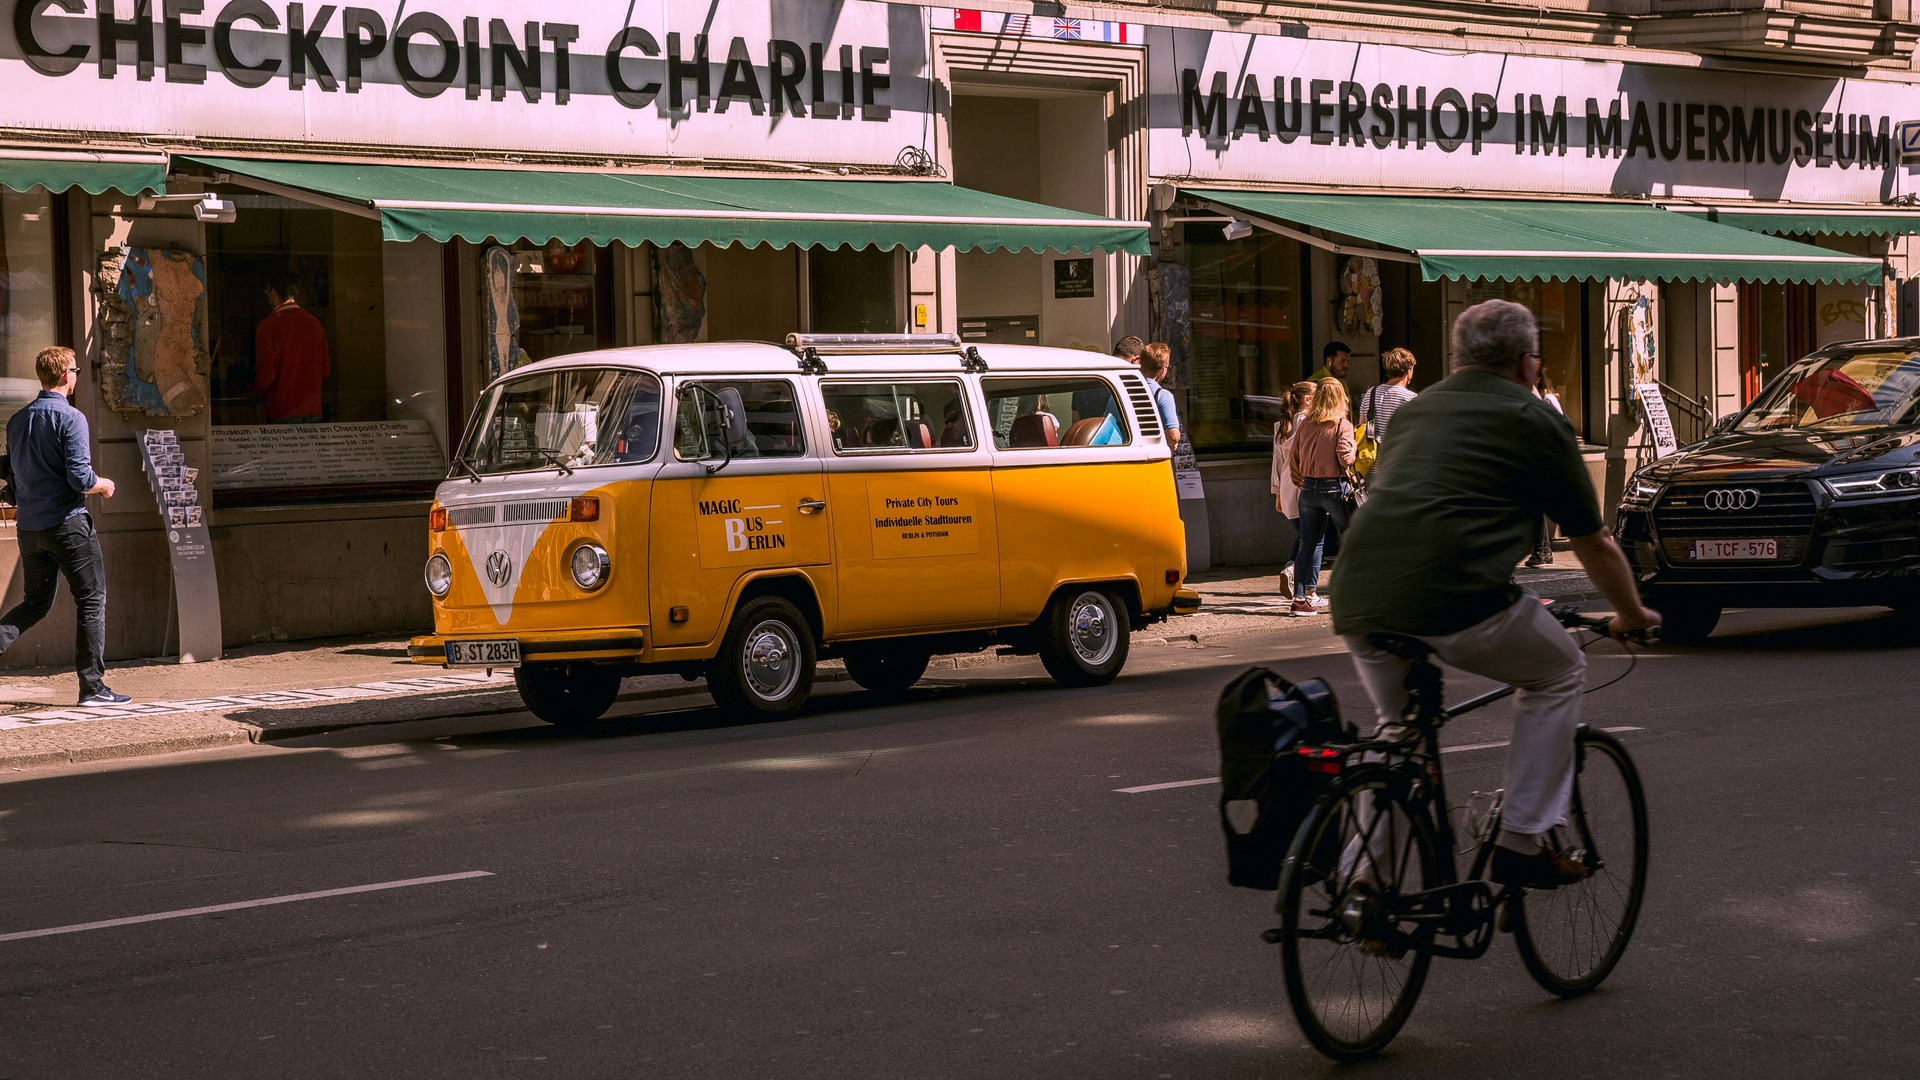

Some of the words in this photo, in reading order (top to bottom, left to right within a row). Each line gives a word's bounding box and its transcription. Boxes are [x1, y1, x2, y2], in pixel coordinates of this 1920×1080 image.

[14, 0, 579, 105] CHECKPOINT
[606, 27, 891, 122] CHARLIE
[1182, 68, 1498, 156] MAUERSHOP
[1515, 93, 1567, 157] IM
[1585, 97, 1890, 170] MAUERMUSEUM
[259, 427, 295, 435] Museum
[295, 426, 318, 434] Haus
[333, 424, 379, 433] Checkpoint
[380, 423, 409, 431] Charlie
[699, 499, 741, 515] MAGIC
[885, 497, 915, 508] Private
[917, 496, 932, 508] City
[935, 495, 958, 507] Tours
[875, 515, 922, 528] Individuelle
[925, 514, 972, 526] Stadttouren
[902, 532, 919, 540] BERLIN
[926, 530, 949, 538] POTSDAM
[453, 644, 462, 661] B
[469, 643, 483, 661] ST
[486, 642, 519, 660] 283H
